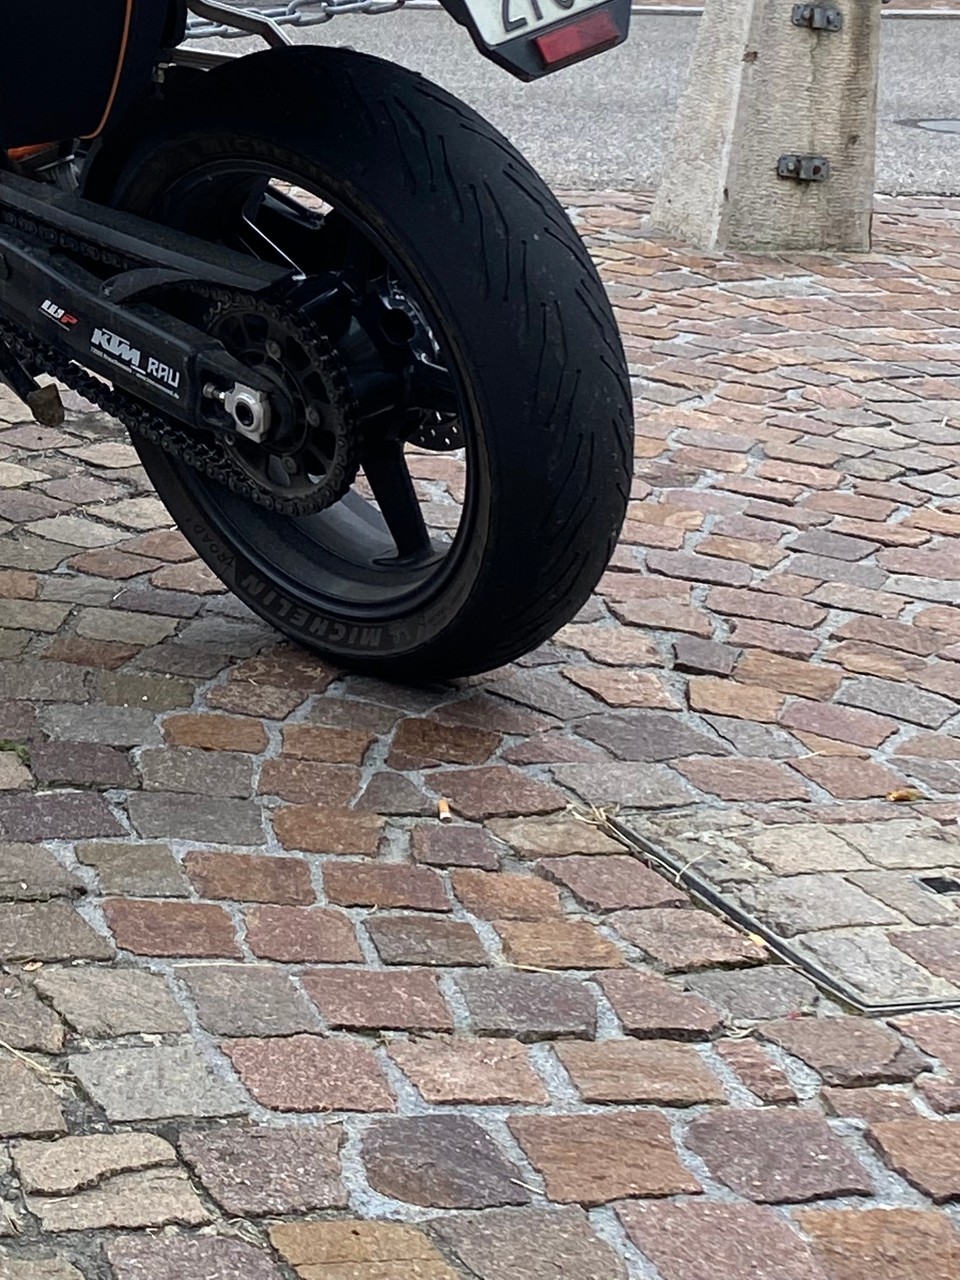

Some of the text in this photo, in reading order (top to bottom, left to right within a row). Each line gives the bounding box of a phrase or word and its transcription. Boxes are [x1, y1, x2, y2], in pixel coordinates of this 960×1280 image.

[40, 299, 79, 326] WP
[90, 327, 141, 367] KTM
[146, 356, 181, 389] RAU
[241, 573, 383, 648] MICHELIN
